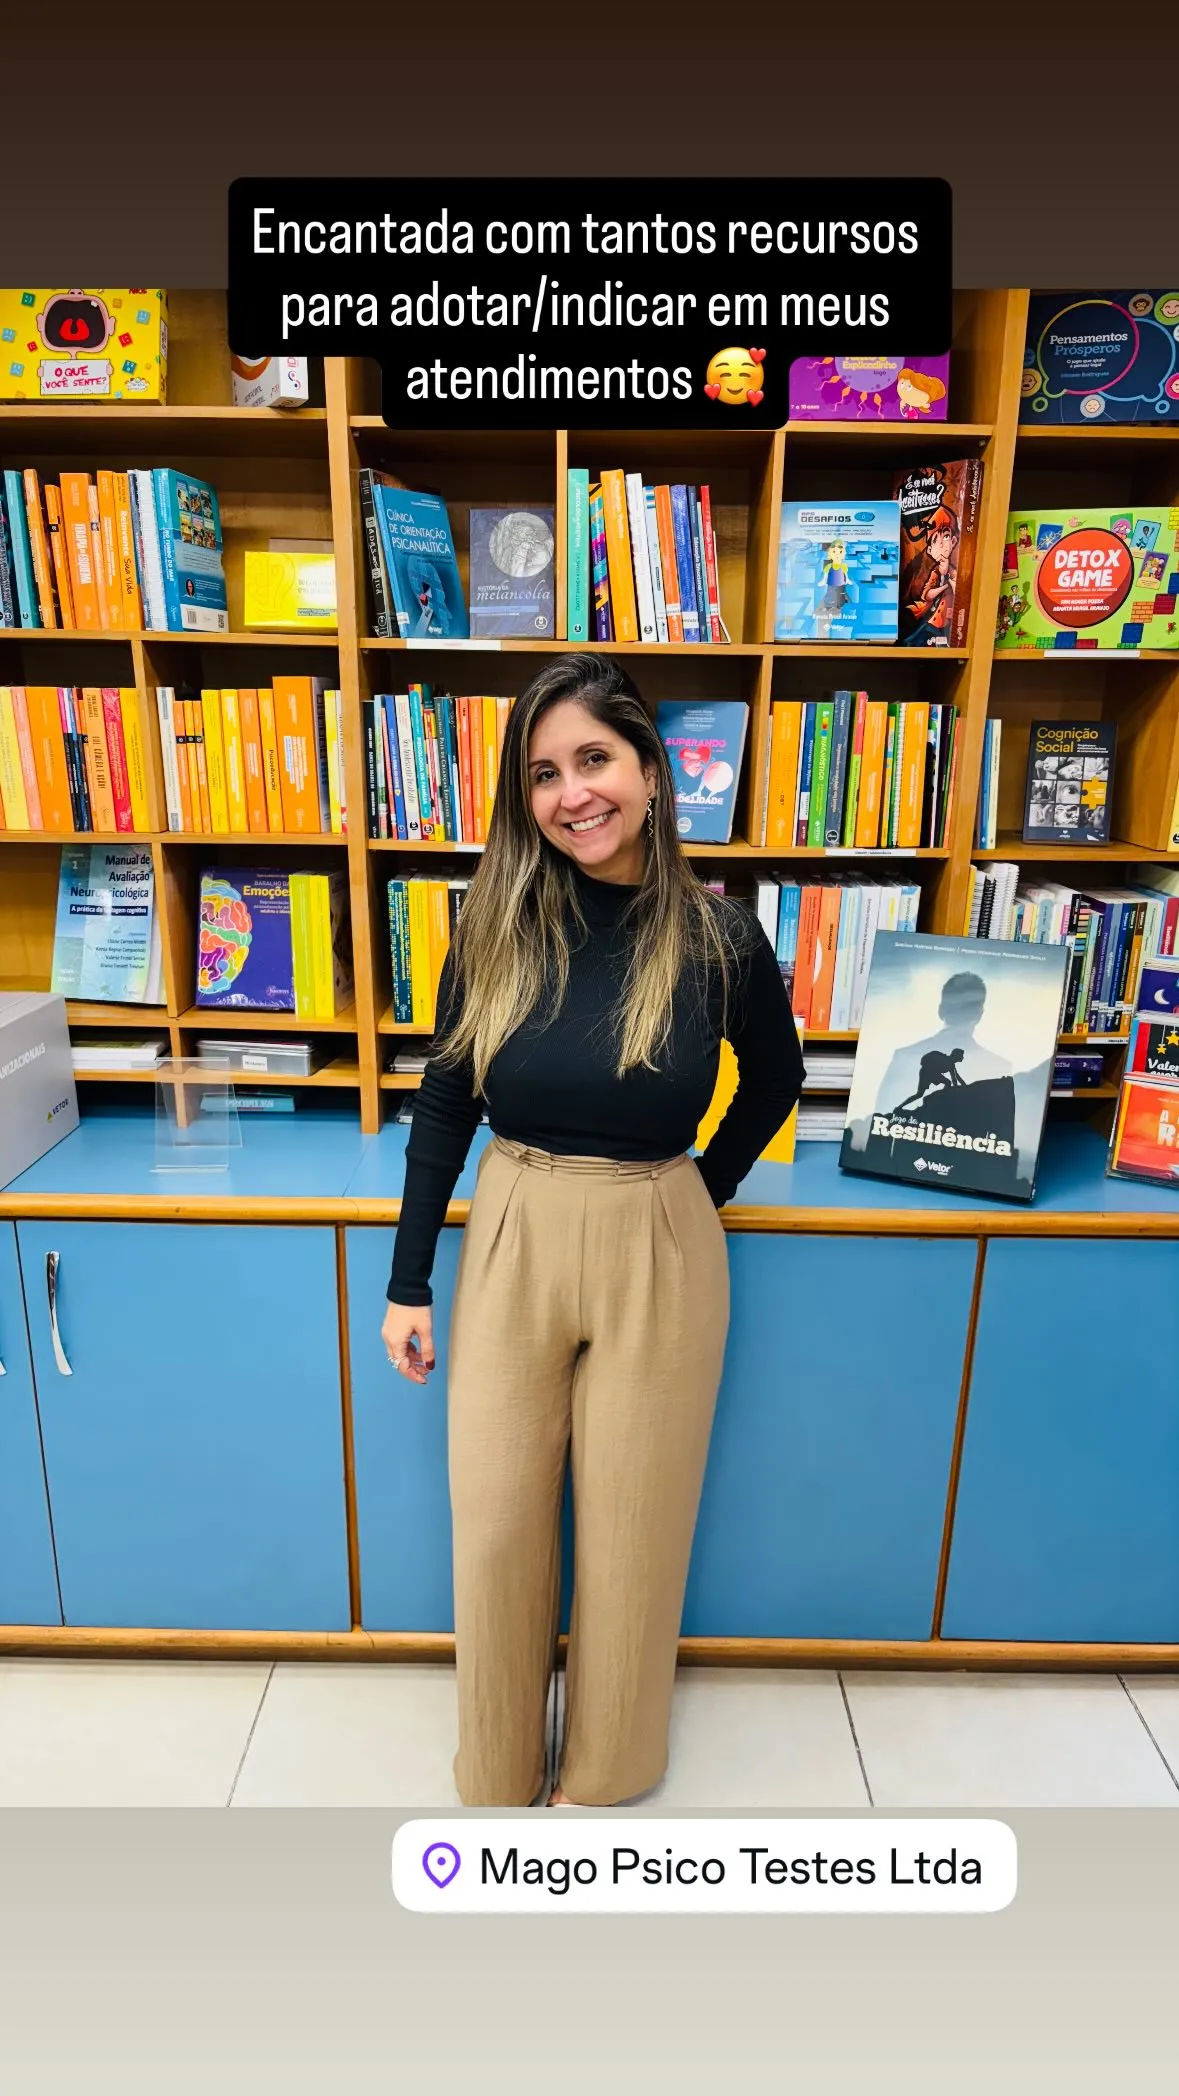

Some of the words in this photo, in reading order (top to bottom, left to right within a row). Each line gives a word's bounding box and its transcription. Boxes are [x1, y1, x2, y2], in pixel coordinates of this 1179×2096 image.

[1050, 332, 1128, 345] Pensamentos
[1054, 344, 1121, 357] Prósperos
[54, 367, 62, 377] O
[64, 365, 89, 376] QUE
[842, 360, 897, 371] Explicadinho
[45, 378, 69, 389] VOCÊ
[72, 377, 107, 387] SENTE?
[801, 515, 852, 523] DESAFIOS
[120, 511, 129, 556] Reinvente
[389, 525, 399, 534] DE
[401, 525, 446, 540] ORIENTAÇÃO
[392, 538, 451, 554] PSICANALÍTICA
[1054, 549, 1122, 569] DETOX
[1058, 569, 1113, 588] GAME
[1037, 727, 1098, 742] Cognição
[665, 737, 727, 748] SUPERANDO
[1036, 741, 1073, 753] Social
[105, 855, 139, 866] Manual
[140, 854, 151, 865] de
[109, 871, 150, 883] Avaliação
[71, 887, 149, 900] Neuricológica
[52, 1098, 69, 1115] VETOR
[1160, 1110, 1169, 1122] A
[871, 1115, 1012, 1157] Resiliência
[927, 1161, 952, 1174] Vetor
